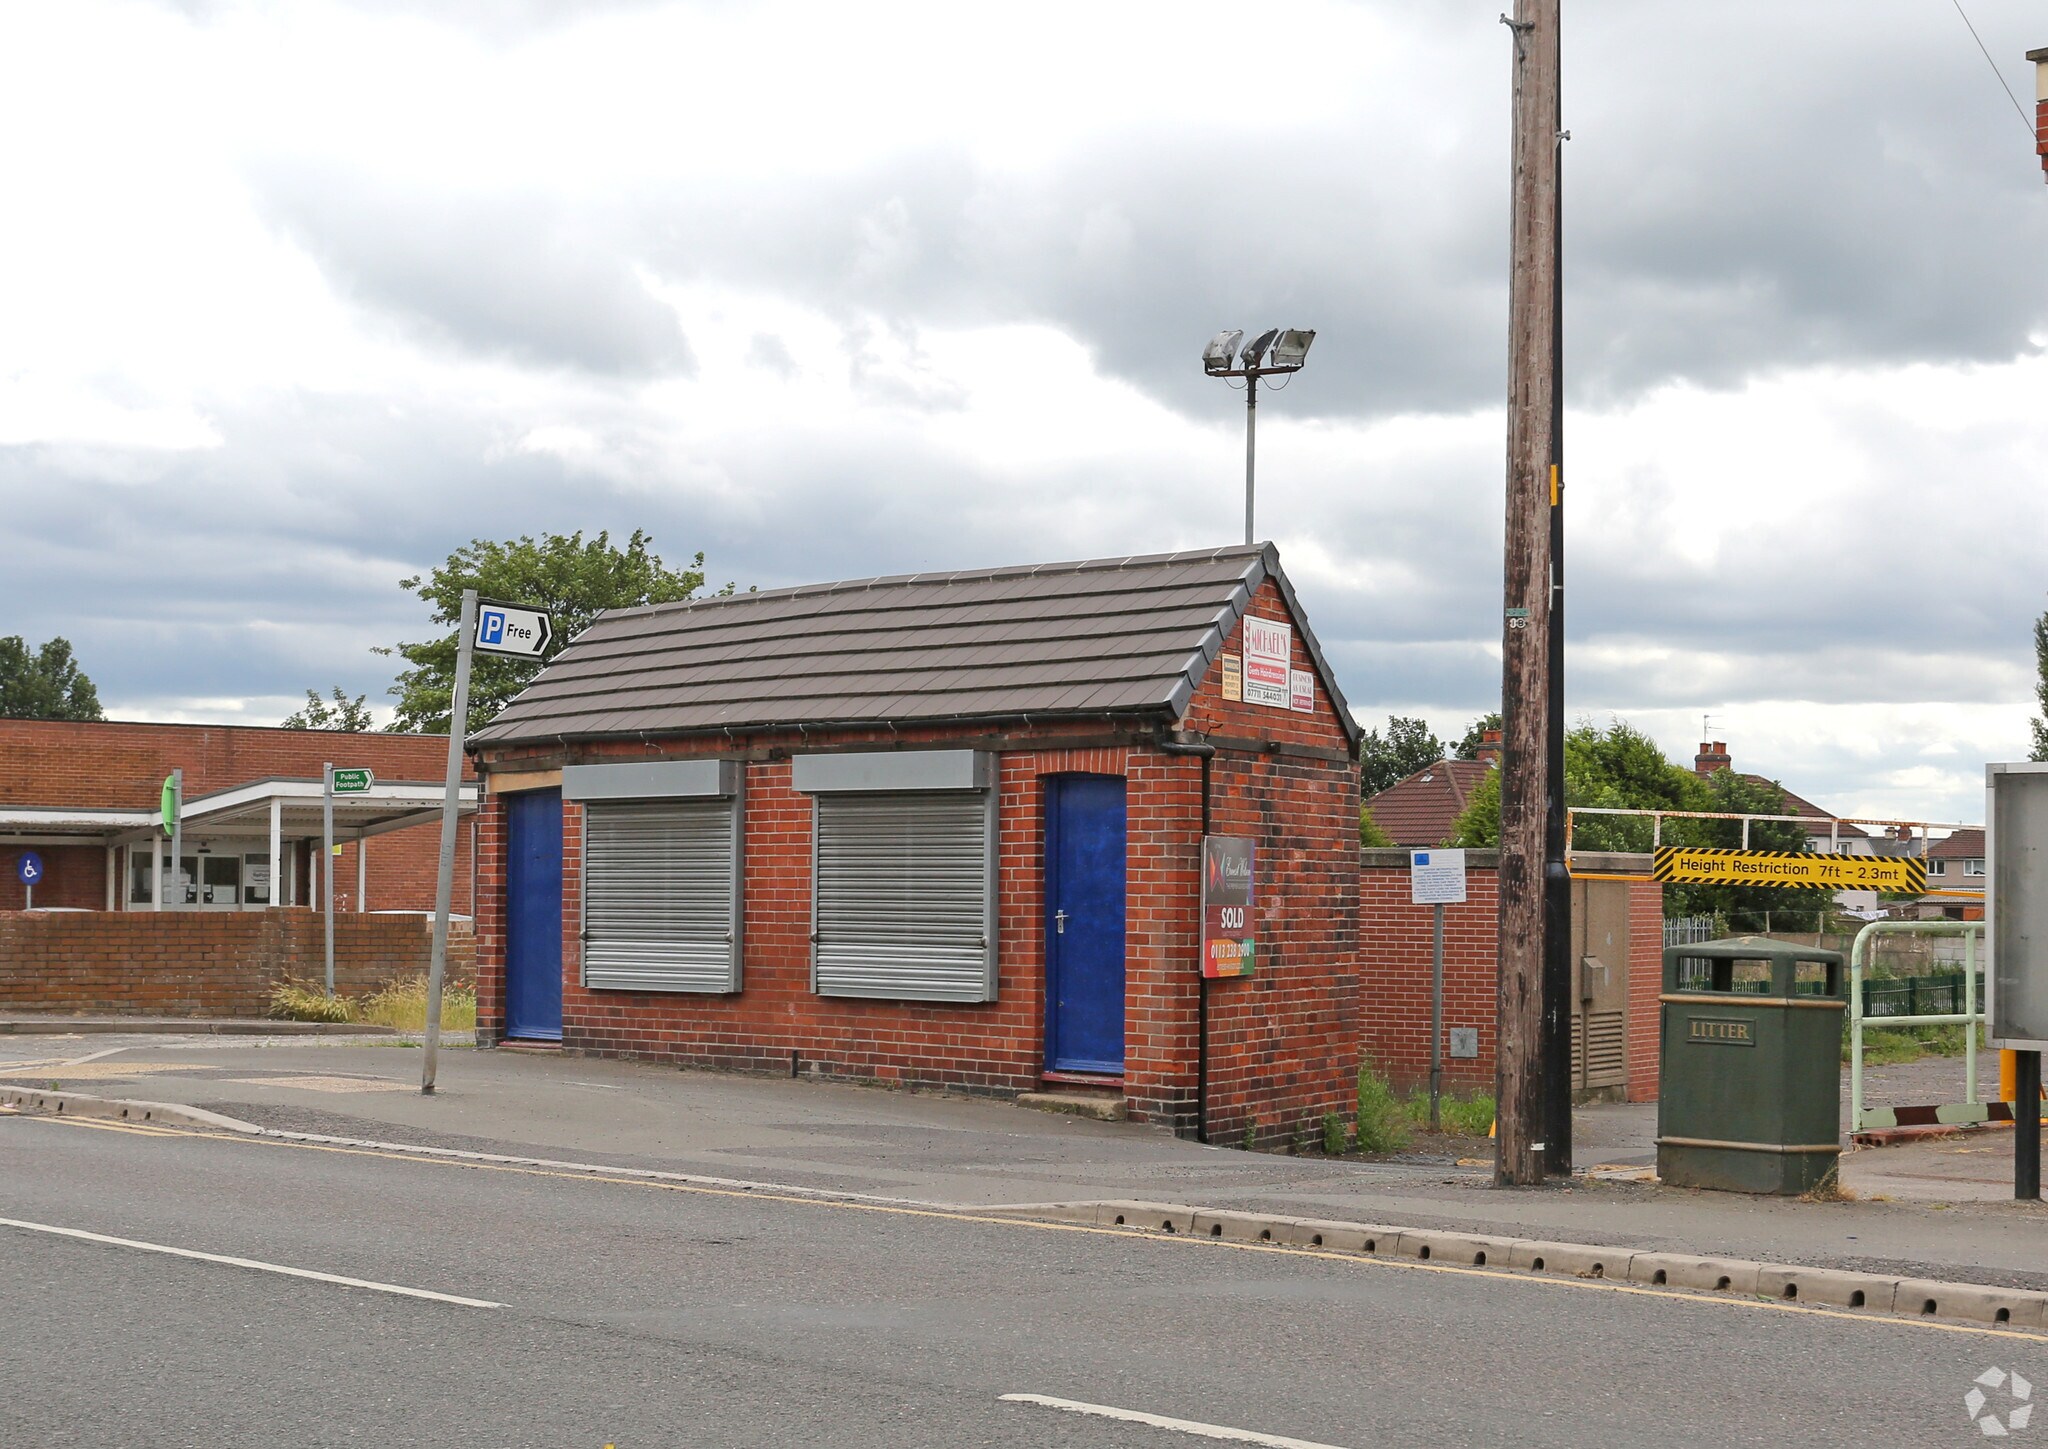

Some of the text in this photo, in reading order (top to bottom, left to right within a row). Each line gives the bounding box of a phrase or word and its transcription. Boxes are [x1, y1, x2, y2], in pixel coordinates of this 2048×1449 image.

[485, 615, 532, 640] P Free
[336, 781, 364, 789] Footpath
[1680, 858, 1726, 873] Height
[1732, 860, 1809, 876] Restriction
[1819, 865, 1841, 878] 7ft
[1858, 867, 1899, 880] 2.3mt
[1221, 907, 1244, 929] SOLD
[1691, 1021, 1750, 1040] LITTER
